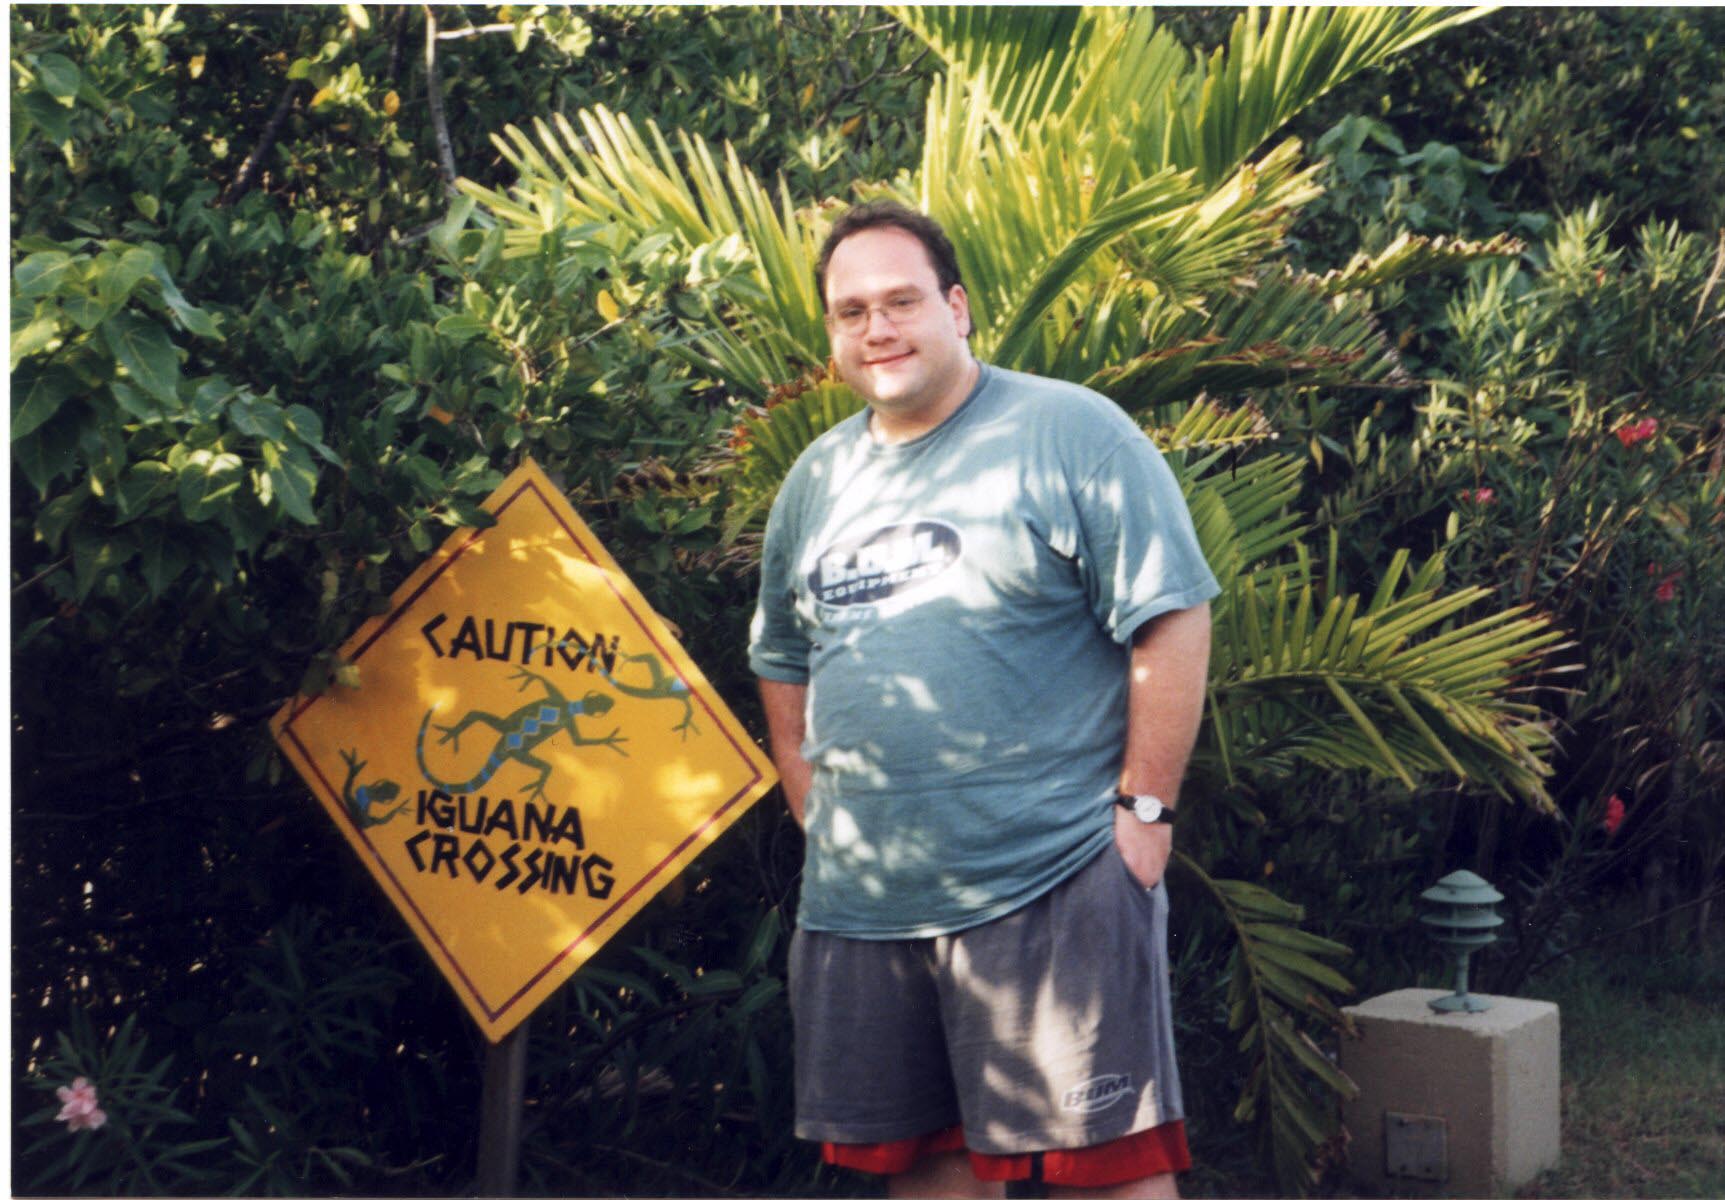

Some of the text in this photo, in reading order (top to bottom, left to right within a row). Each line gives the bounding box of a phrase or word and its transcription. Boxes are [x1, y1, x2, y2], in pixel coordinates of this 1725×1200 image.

[822, 560, 944, 601] EQUIPM
[420, 612, 620, 674] CAUTION
[416, 788, 586, 851] IGUANA
[404, 828, 616, 900] CROSSING
